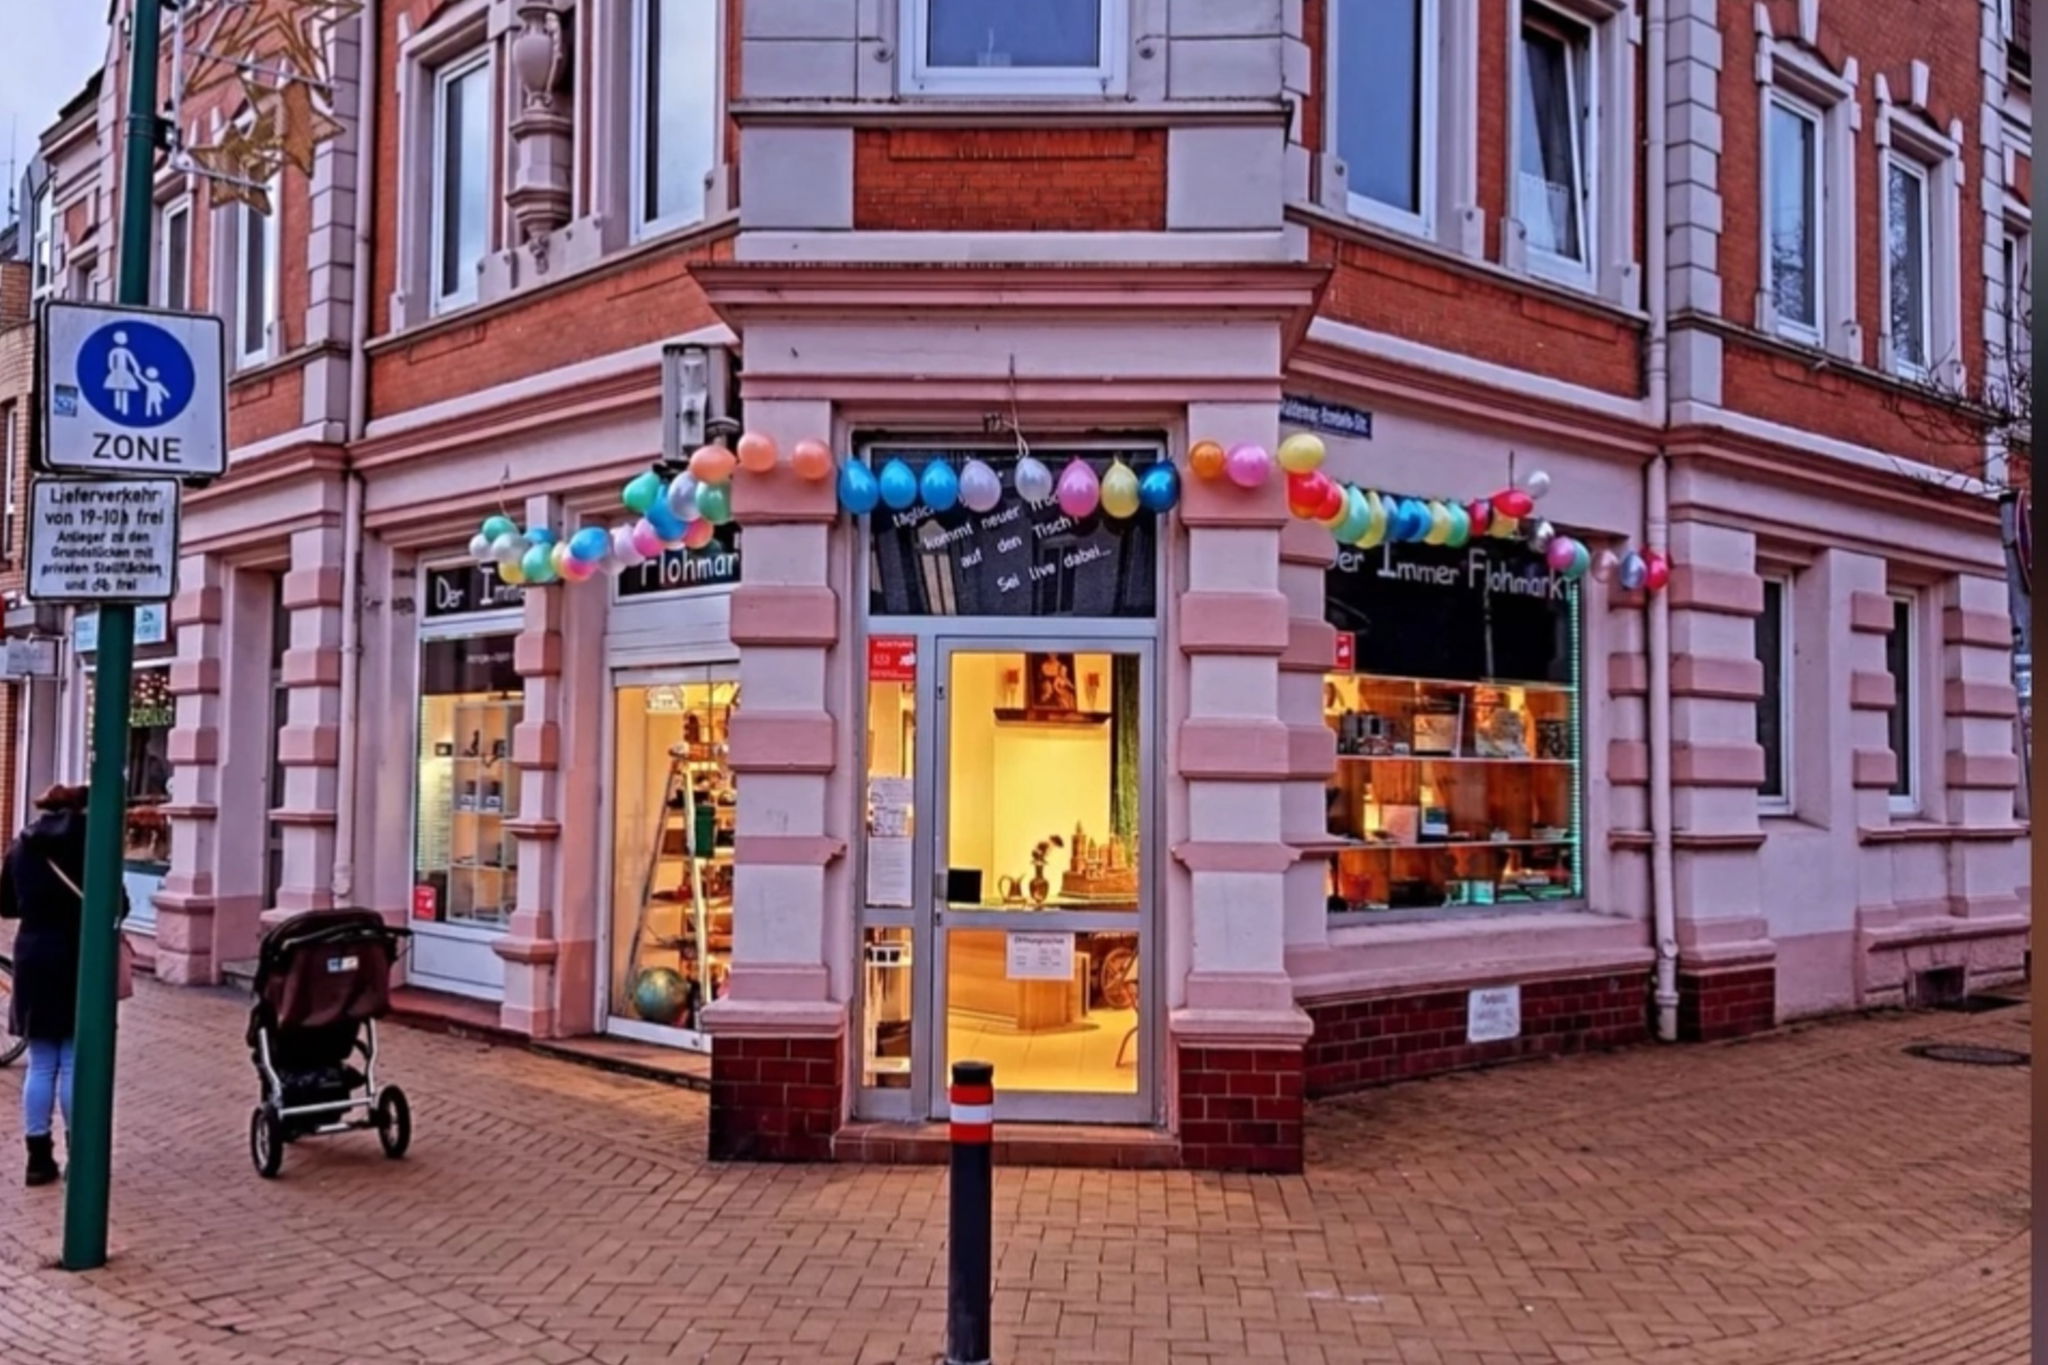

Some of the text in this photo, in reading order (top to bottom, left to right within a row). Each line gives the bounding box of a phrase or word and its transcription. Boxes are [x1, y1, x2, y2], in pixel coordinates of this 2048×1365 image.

[93, 433, 181, 463] ZONE
[50, 486, 162, 505] Lieferverkehr
[45, 511, 74, 525] von
[136, 507, 164, 526] frei
[923, 505, 1020, 550] kommt neuer
[57, 530, 106, 545] Anlieger
[127, 530, 150, 542] den
[133, 546, 154, 559] mit
[960, 548, 983, 569] auf
[997, 534, 1022, 554] den
[41, 562, 89, 577] privaten
[1376, 541, 1460, 584] Immer
[65, 578, 137, 591] und frei
[436, 574, 464, 610] Der
[997, 573, 1021, 593] Sei
